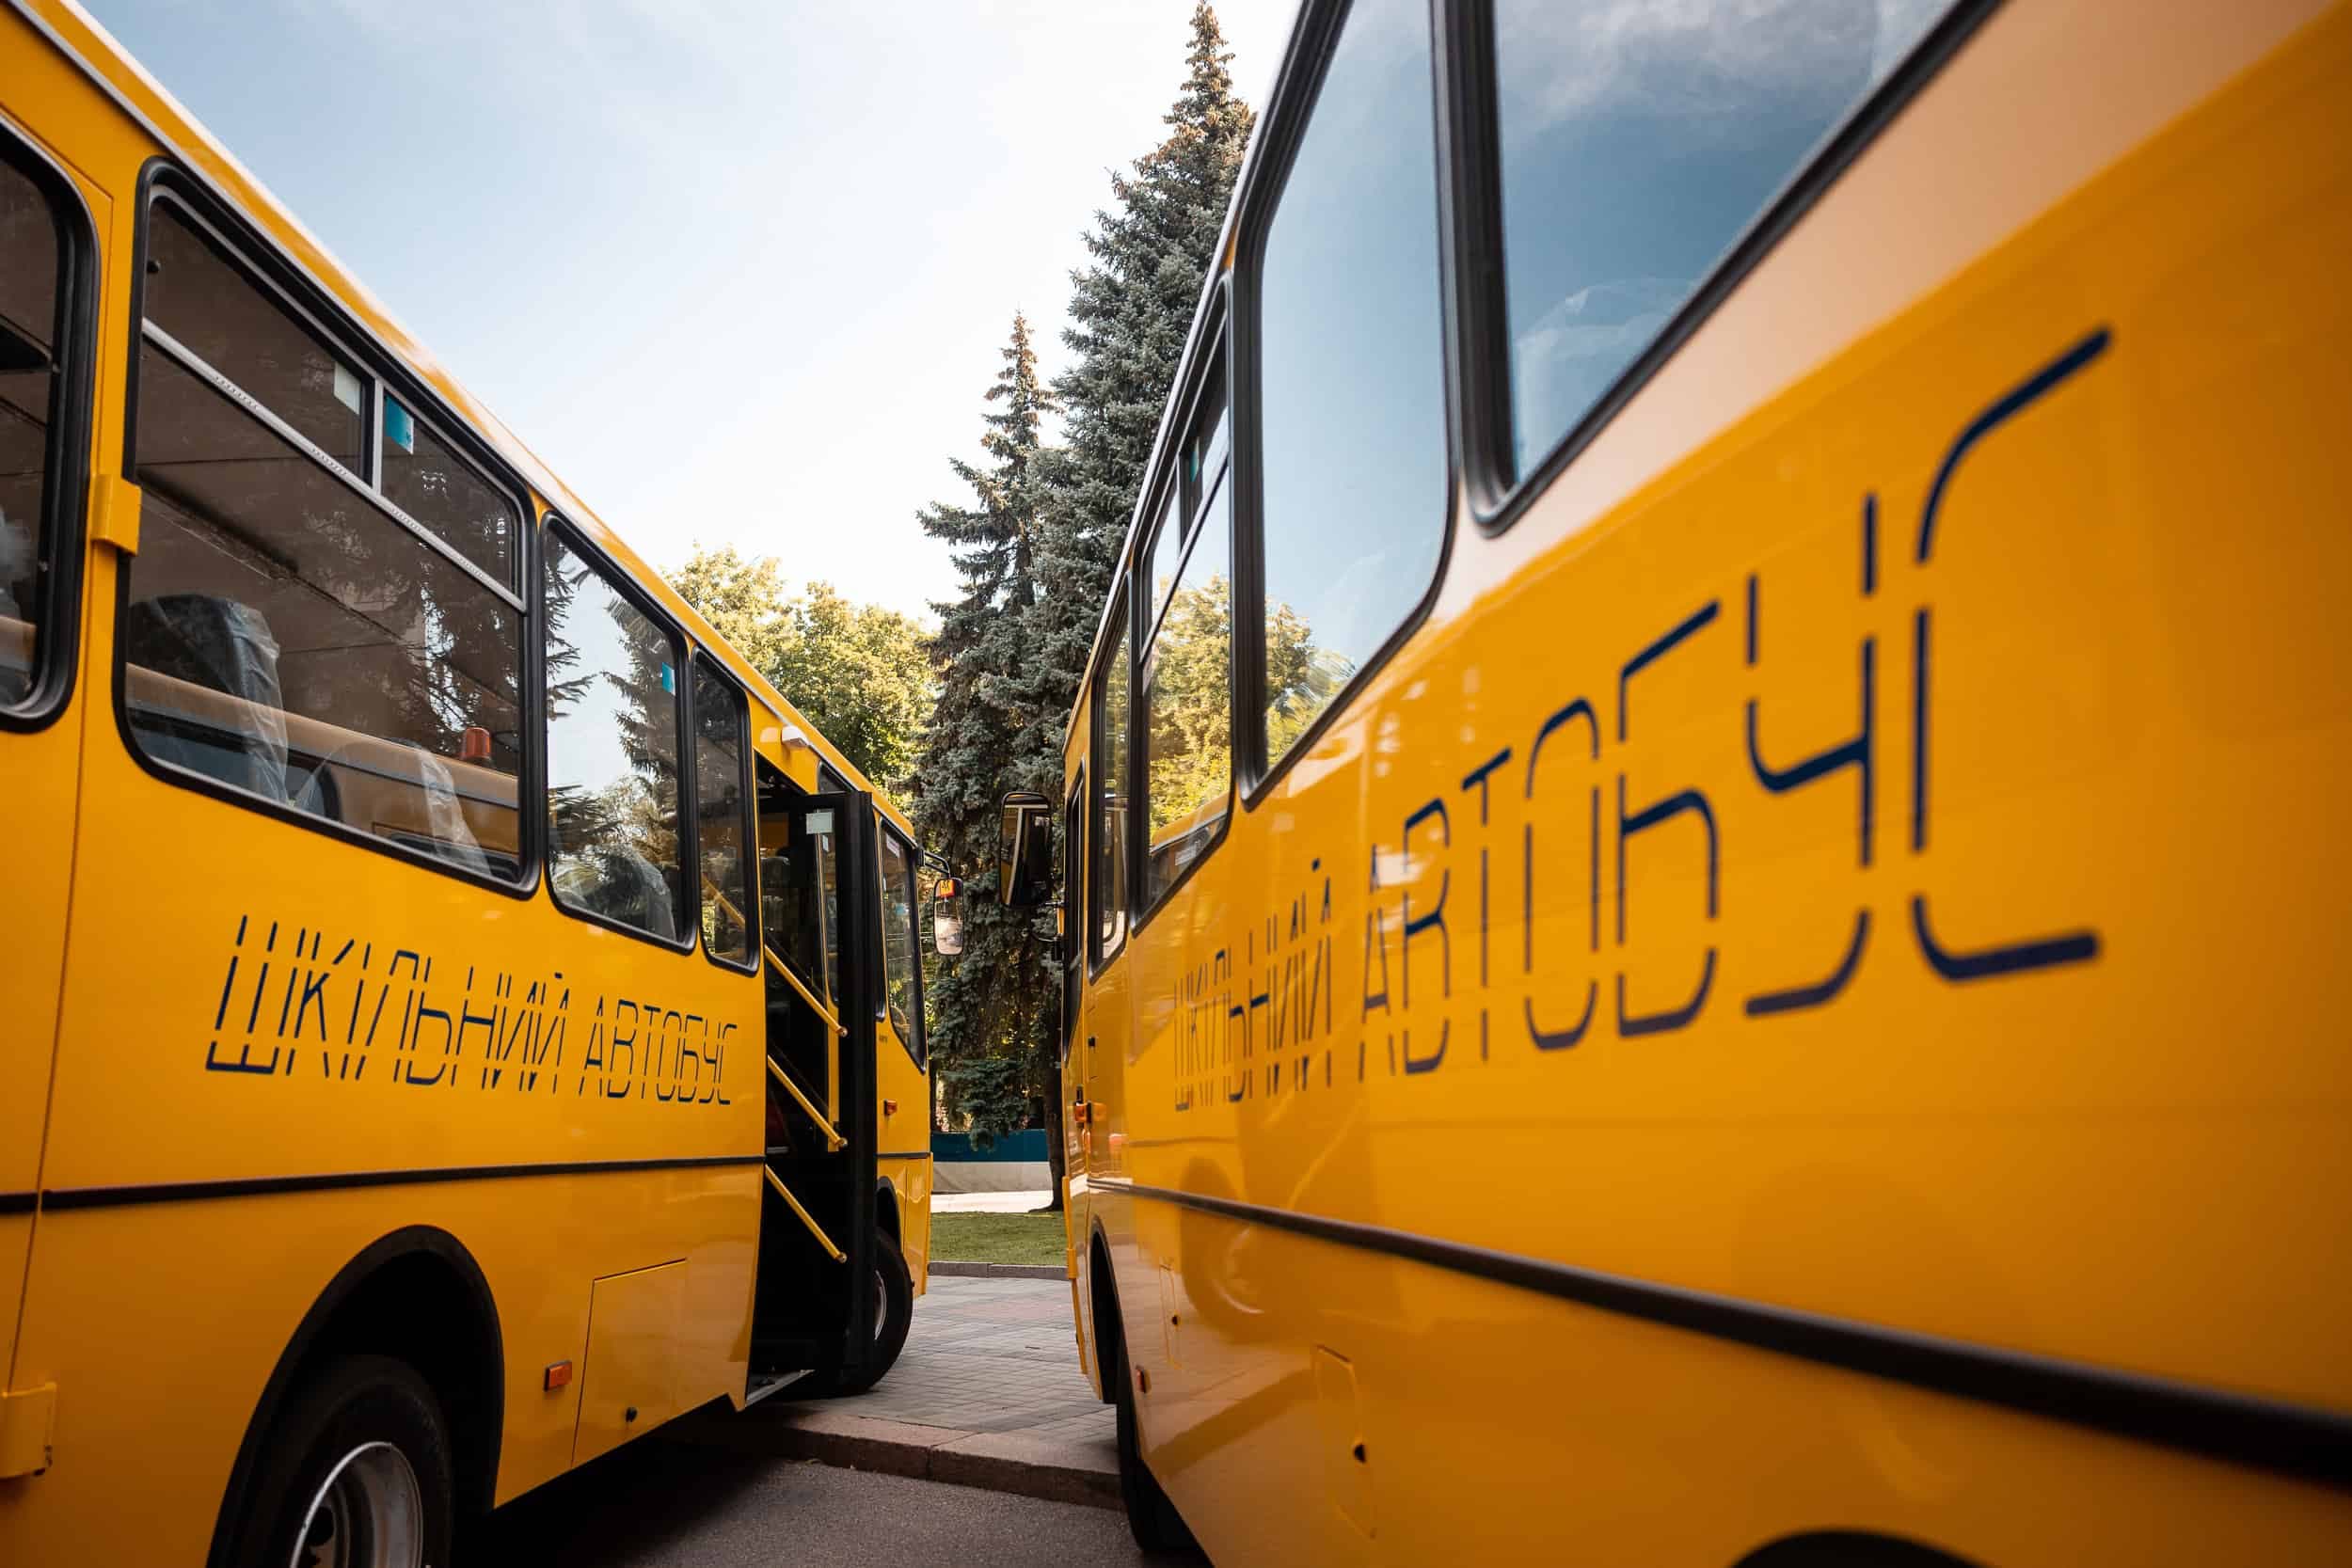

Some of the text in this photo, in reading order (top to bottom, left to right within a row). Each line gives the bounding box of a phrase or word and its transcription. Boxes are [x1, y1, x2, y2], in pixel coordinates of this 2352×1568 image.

[1174, 325, 2113, 1111] ШКІЛЬНИЙ АВТОБУС
[206, 914, 738, 1105] ШКІЛЬНИЙ АВТОБУС
